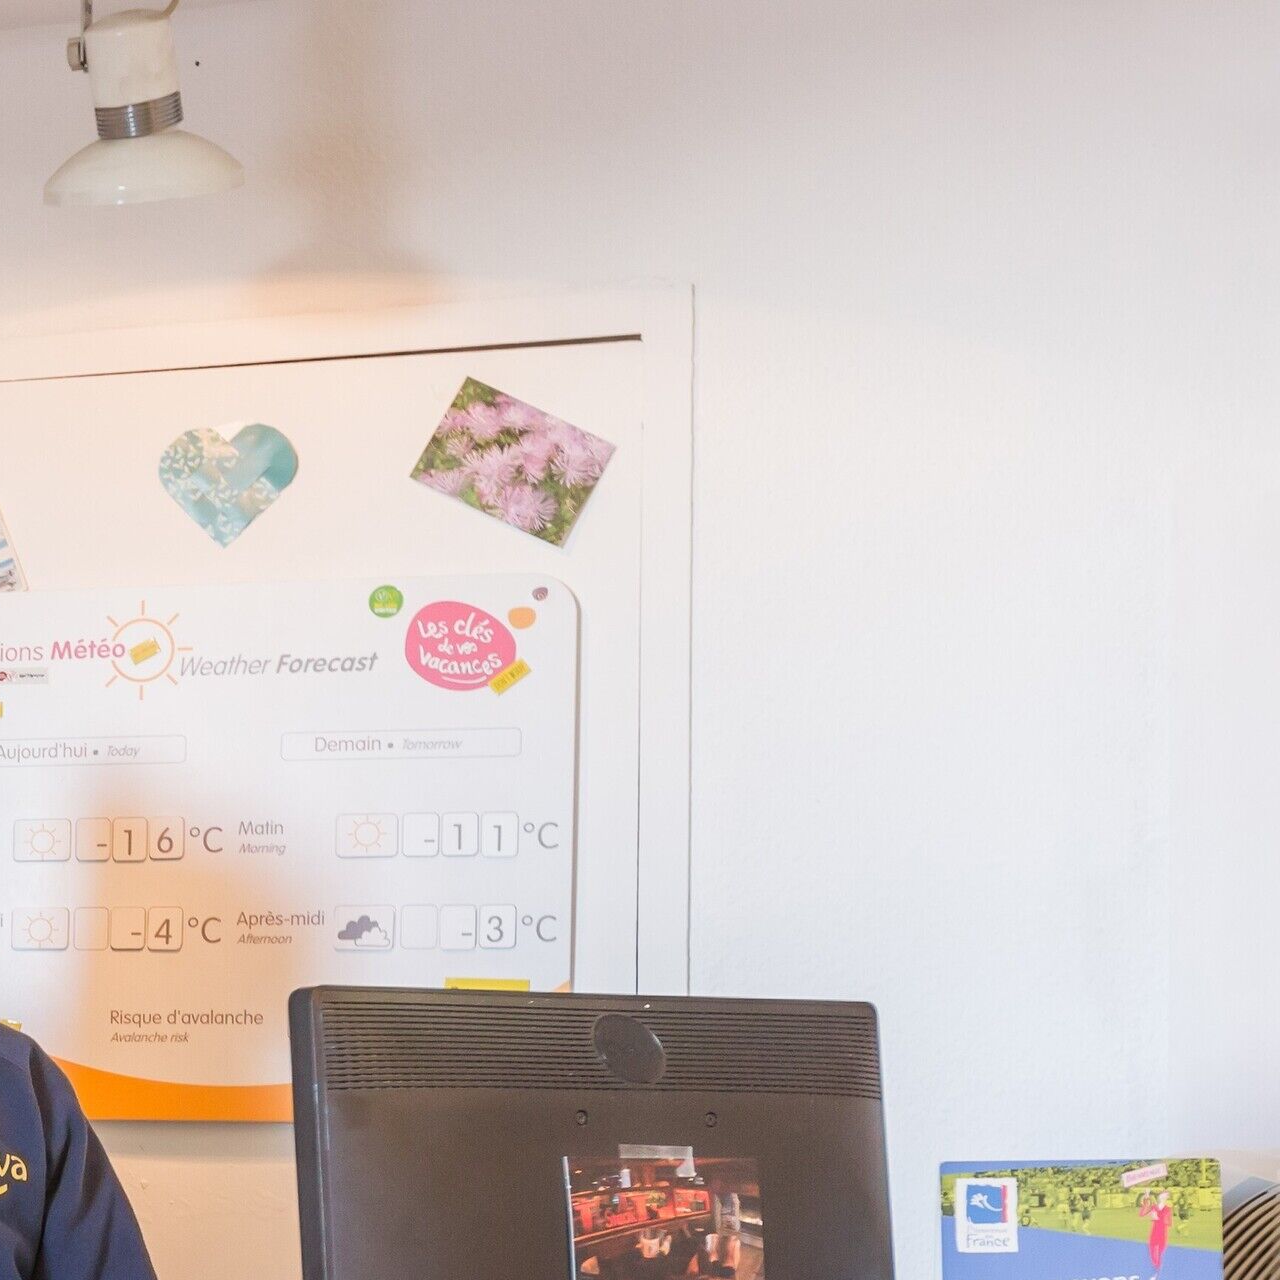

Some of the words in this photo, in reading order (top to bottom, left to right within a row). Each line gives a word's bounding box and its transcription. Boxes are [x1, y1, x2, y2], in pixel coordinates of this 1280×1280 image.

[453, 611, 495, 644] clés
[50, 637, 126, 661] Météo
[437, 637, 453, 656] de
[179, 653, 273, 677] Weather
[275, 651, 379, 675] Forecast
[105, 744, 140, 758] Today
[314, 735, 382, 753] Demain
[402, 737, 464, 751] Tomorrow
[238, 820, 285, 836] Matin
[522, 821, 560, 850] °C
[189, 826, 224, 854] °C
[239, 842, 286, 857] Morning
[236, 909, 325, 927] Après-midi
[187, 915, 222, 944] °C
[521, 914, 558, 942] °C
[236, 932, 293, 946] Afternoon
[110, 1009, 162, 1027] Risque
[166, 1009, 264, 1025] d'avalanche
[110, 1032, 168, 1043] Avalanche
[170, 1032, 190, 1043] risk
[966, 1233, 1010, 1249] France
